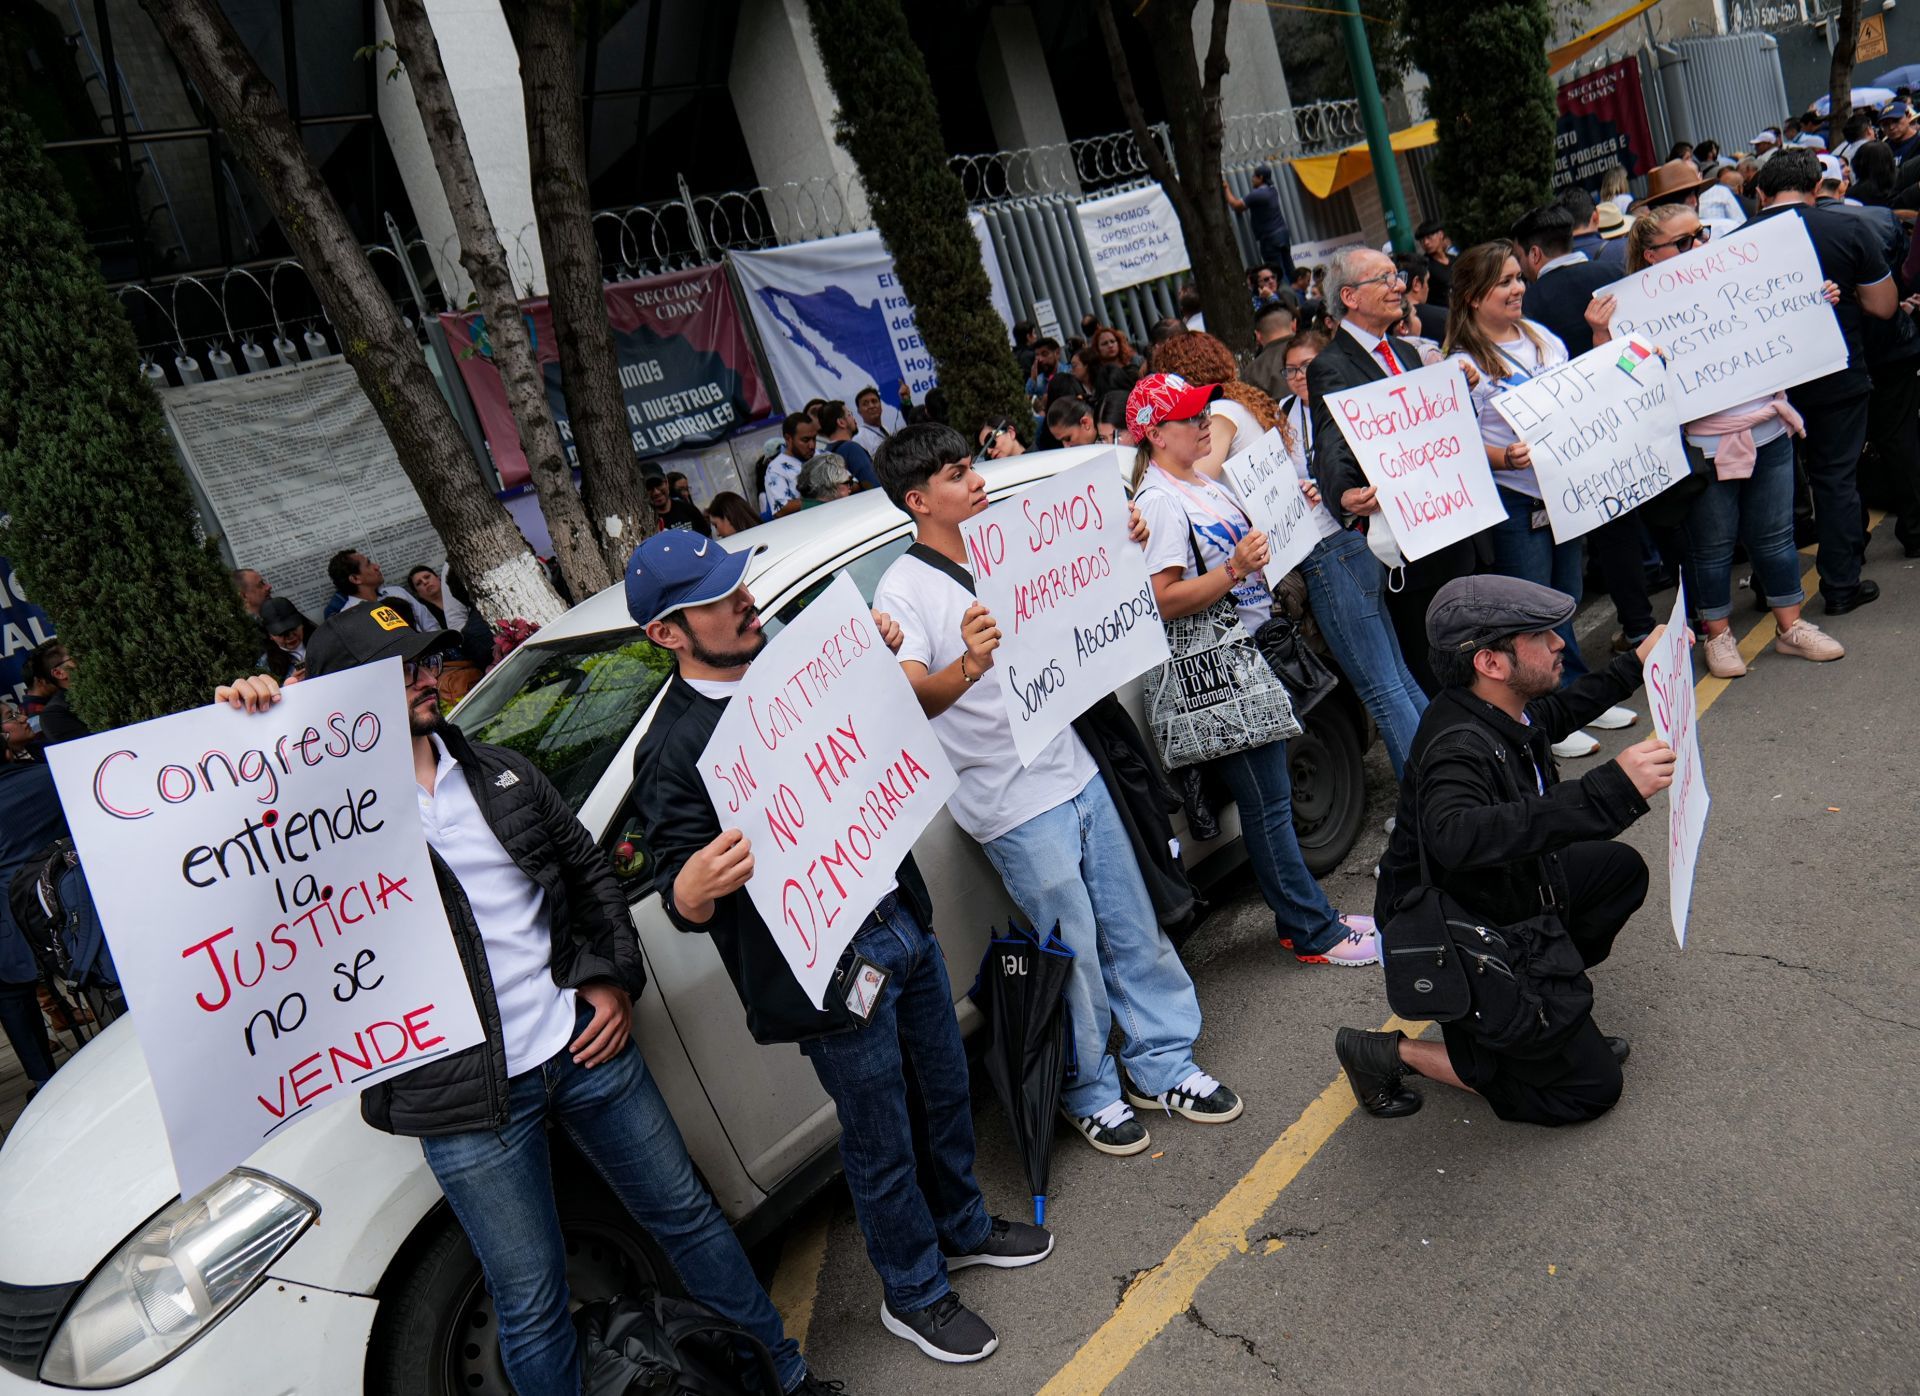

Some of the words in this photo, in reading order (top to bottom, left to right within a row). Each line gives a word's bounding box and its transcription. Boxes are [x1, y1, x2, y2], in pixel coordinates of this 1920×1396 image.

[1581, 83, 1616, 104] CDMX
[1554, 130, 1577, 149] ETO
[1570, 138, 1617, 166] PODERES
[1619, 134, 1627, 148] E
[1576, 154, 1621, 180] JUDICIAL
[1097, 216, 1112, 229] NO
[1114, 205, 1150, 223] SOMOS
[1097, 239, 1146, 261] SERVIMOS
[1158, 232, 1169, 243] LA
[877, 273, 894, 288] El
[1641, 241, 1759, 299] CONGRESO
[1718, 271, 1803, 311] RESPETO
[634, 281, 702, 307] SECCIÓN
[655, 300, 703, 320] CDMX
[885, 296, 908, 309] tra
[1661, 314, 1747, 363] UESTROS
[1755, 290, 1828, 324] DERECHO
[618, 360, 664, 389] IMOS
[905, 355, 932, 372] Hoy
[1677, 335, 1793, 394] LABORALES
[627, 405, 642, 424] A
[642, 382, 724, 421] NUESTROS
[1338, 399, 1396, 441] Poder
[1389, 379, 1459, 431] Judicial
[1501, 393, 1552, 431] EL
[1536, 358, 1595, 408] PJF
[650, 402, 735, 447] LABORALES
[1535, 407, 1622, 466] Trabaja
[1624, 383, 1666, 423] para
[1379, 436, 1460, 478] Contrapeso
[1562, 456, 1637, 513] defender
[1635, 443, 1662, 472] tus
[1023, 484, 1102, 553] SOMOS
[1395, 474, 1474, 531] Nacional
[1014, 547, 1111, 634] ACARREADOS
[0, 616, 58, 660] AL
[1009, 658, 1065, 722] SOMOS
[1074, 580, 1159, 667] ABOGADOS!
[1175, 649, 1222, 679] TOKYO
[1180, 667, 1228, 695] TOWN
[714, 745, 757, 813] SIN
[748, 618, 872, 751] CONTRAPESO
[1186, 686, 1232, 710] totemap
[93, 711, 382, 820] Congreso
[765, 783, 804, 852] NO
[804, 714, 867, 803] HAY
[182, 788, 385, 888] entiende
[782, 749, 930, 969] DEMOCRACIA
[275, 874, 322, 914] la
[182, 871, 414, 1012] JUSTICIA
[244, 992, 307, 1056] no
[333, 948, 385, 1002] se
[257, 1003, 446, 1118] VENDE
